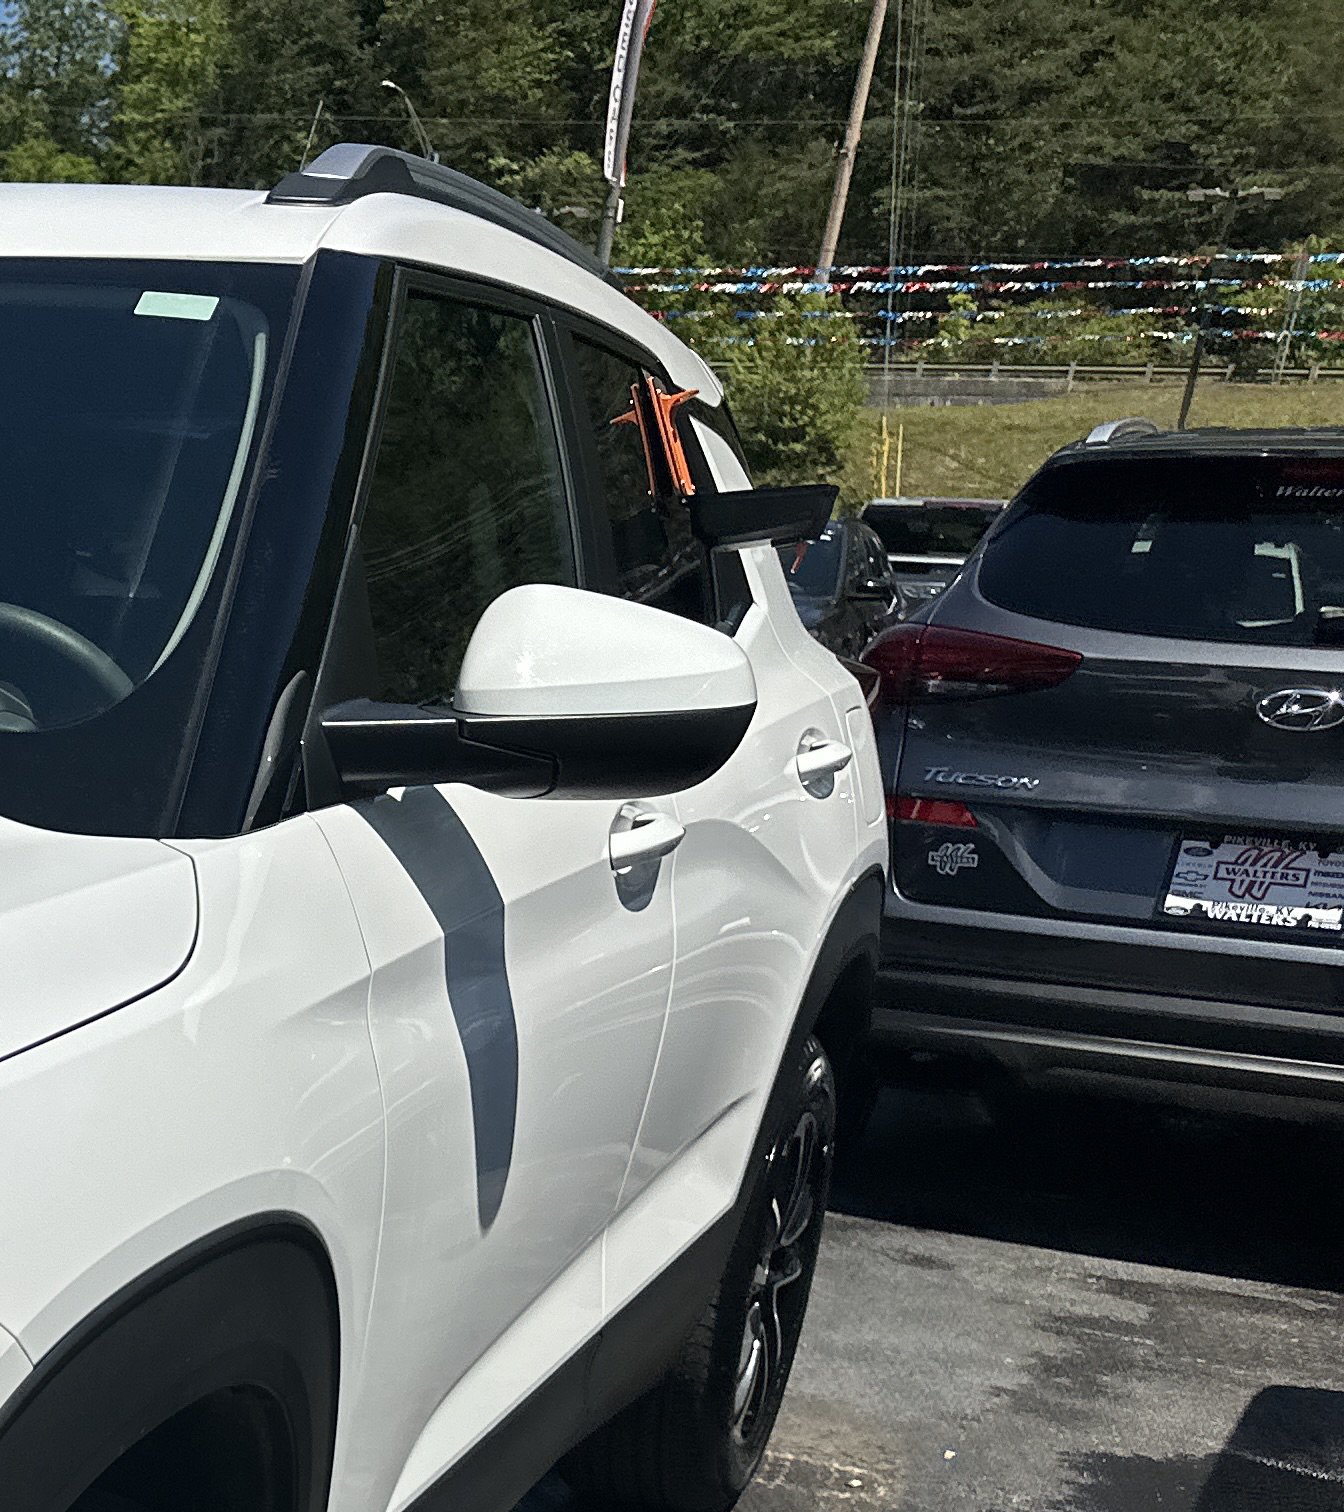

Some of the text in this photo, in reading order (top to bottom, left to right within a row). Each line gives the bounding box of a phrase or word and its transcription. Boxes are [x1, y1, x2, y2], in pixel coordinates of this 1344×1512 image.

[923, 766, 1040, 789] TUCSON
[1224, 866, 1301, 883] WALTERS
[1202, 905, 1298, 928] WALTERS
